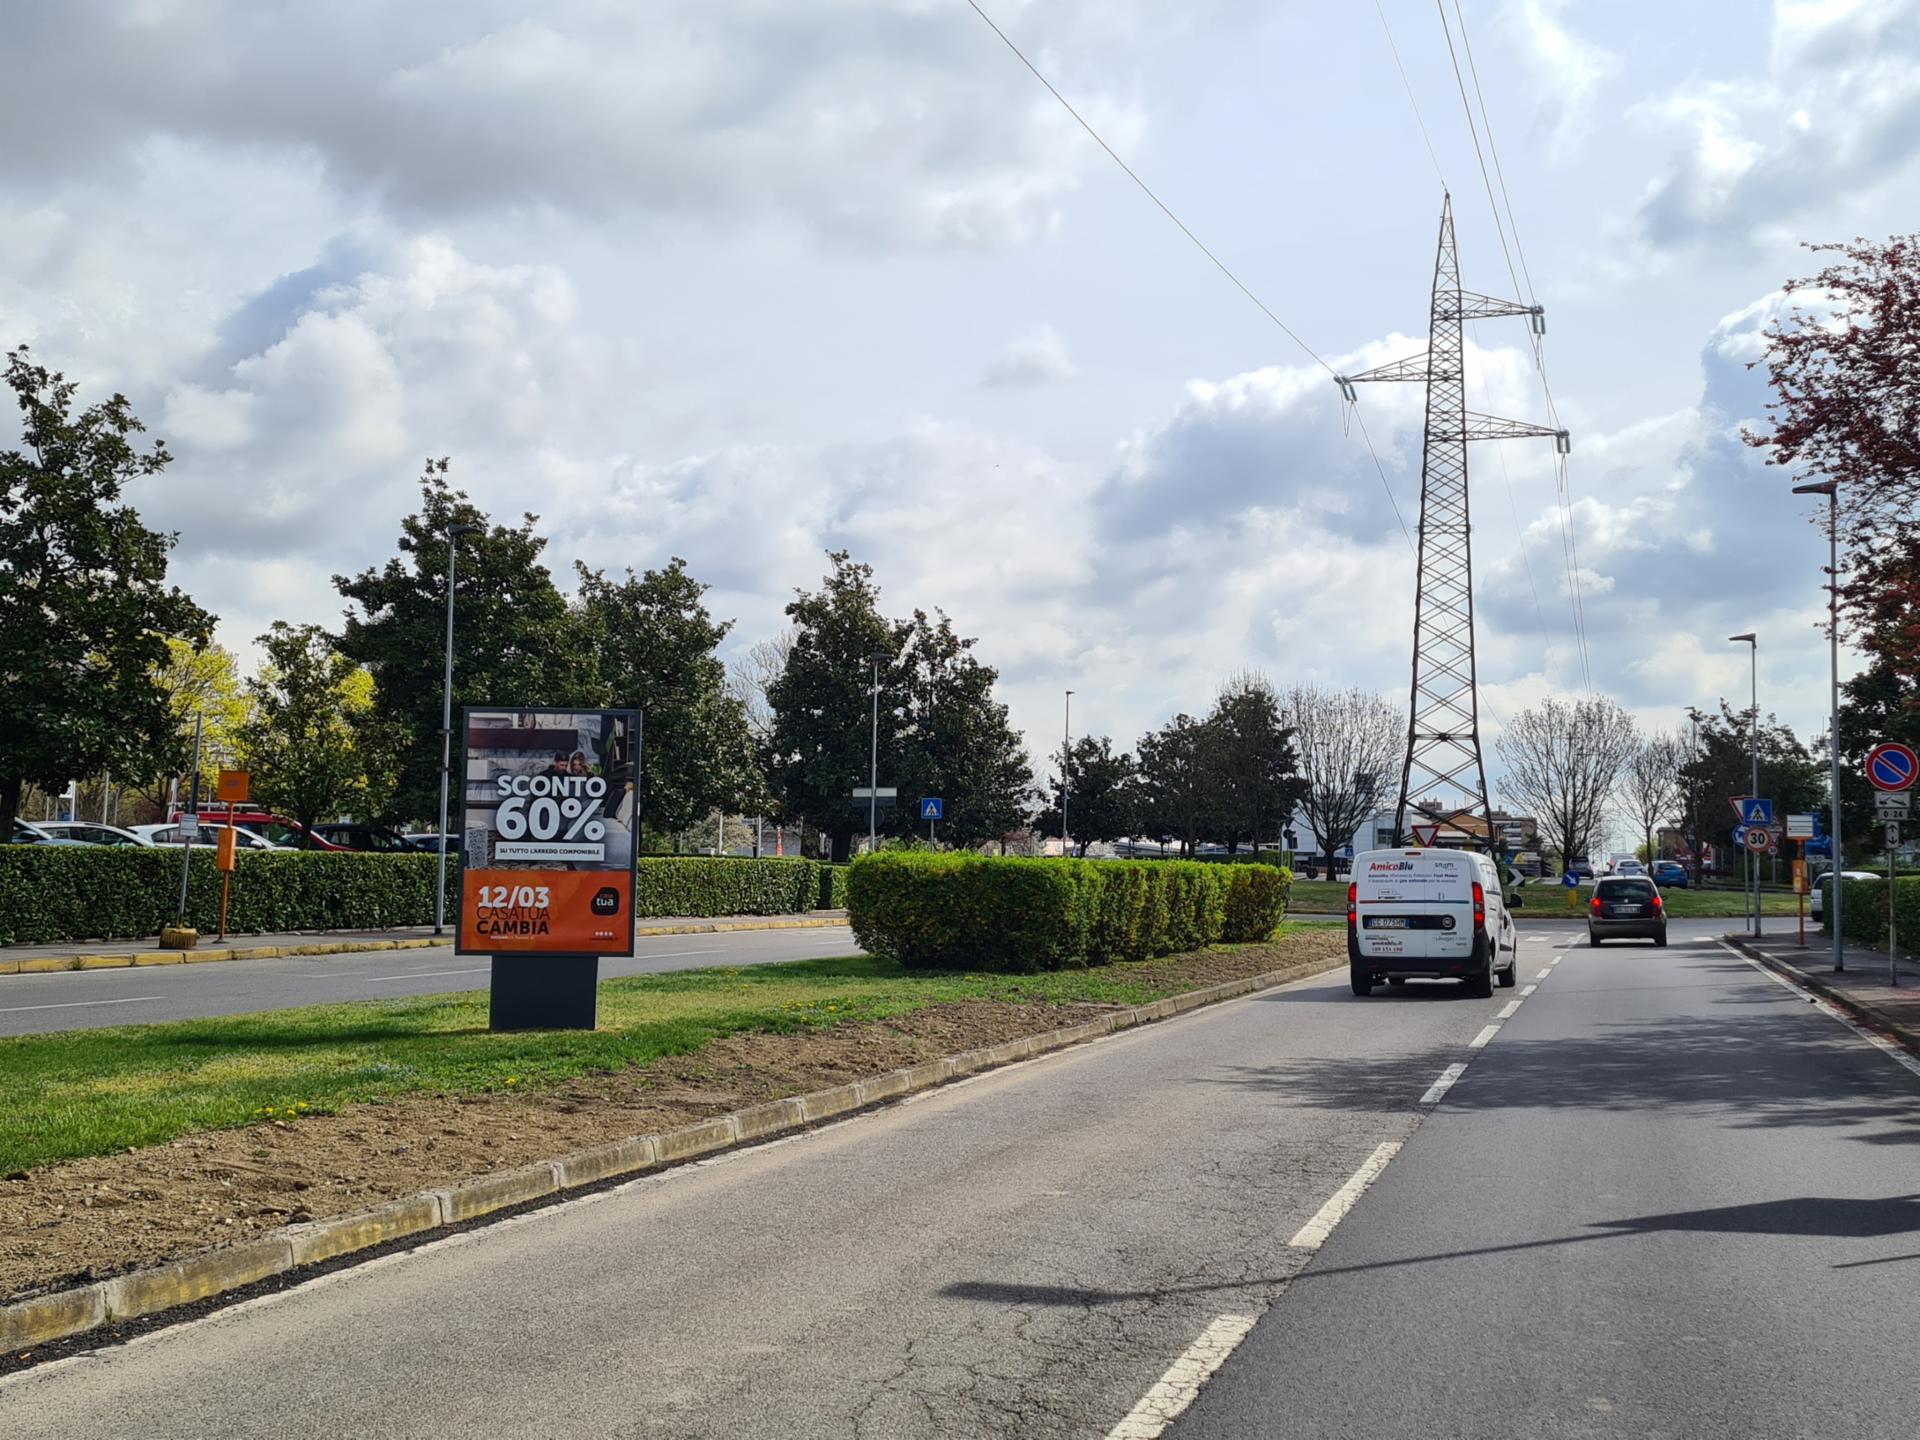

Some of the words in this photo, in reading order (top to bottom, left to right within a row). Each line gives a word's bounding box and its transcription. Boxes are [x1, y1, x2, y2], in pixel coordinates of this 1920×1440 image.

[496, 775, 607, 798] SCONTO
[495, 797, 606, 841] 60%
[1750, 833, 1766, 845] 30
[1369, 861, 1414, 871] AmicoBlu
[478, 885, 550, 909] 12/03
[596, 897, 614, 906] tua
[476, 907, 551, 920] CASATUA
[476, 920, 549, 935] CAMBIA
